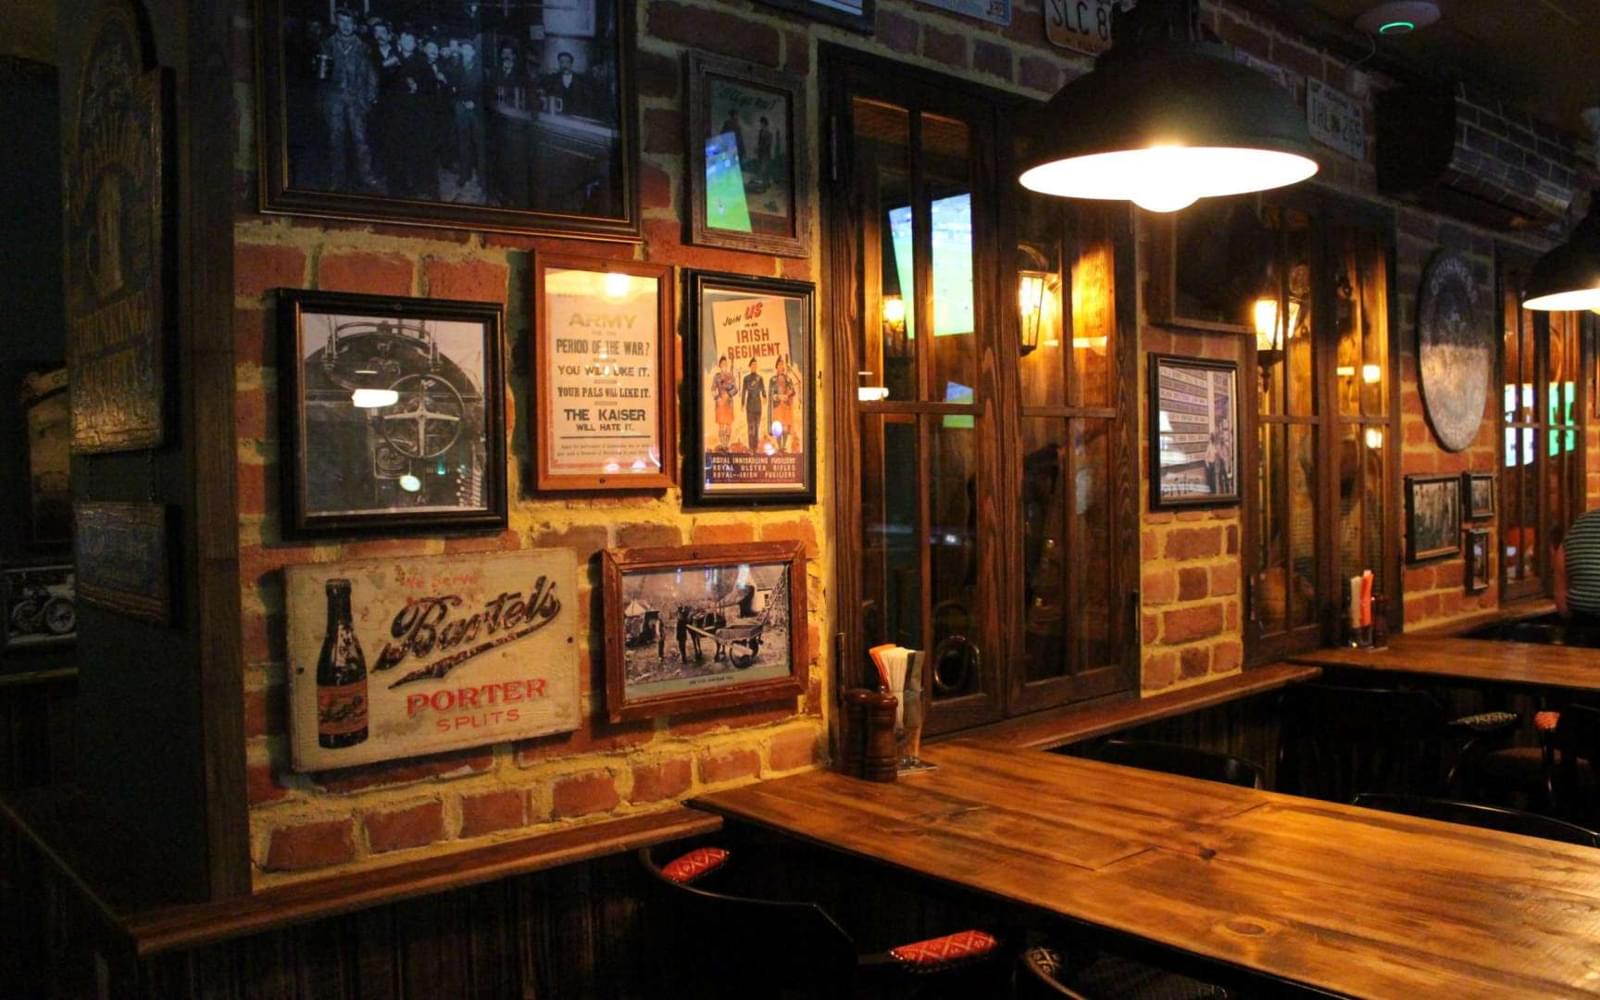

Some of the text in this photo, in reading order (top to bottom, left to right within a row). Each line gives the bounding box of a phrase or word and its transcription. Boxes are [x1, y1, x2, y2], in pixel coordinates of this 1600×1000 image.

[1050, 0, 1089, 35] SLC
[744, 302, 763, 320] US
[569, 312, 637, 328] ARMY
[736, 328, 769, 343] IRISH
[556, 339, 588, 354] PERIOD
[592, 340, 601, 354] OF
[606, 340, 619, 355] THE
[727, 342, 781, 360] REGIMENT
[558, 366, 580, 376] YOU
[557, 387, 580, 397] YOUR
[582, 387, 604, 398] PALS
[620, 387, 639, 398] LIKE
[563, 408, 646, 421] THE KAISER
[576, 423, 596, 431] WILL
[600, 423, 621, 431] HATE
[406, 679, 546, 717] PORTER
[436, 709, 520, 732] SPLITS
